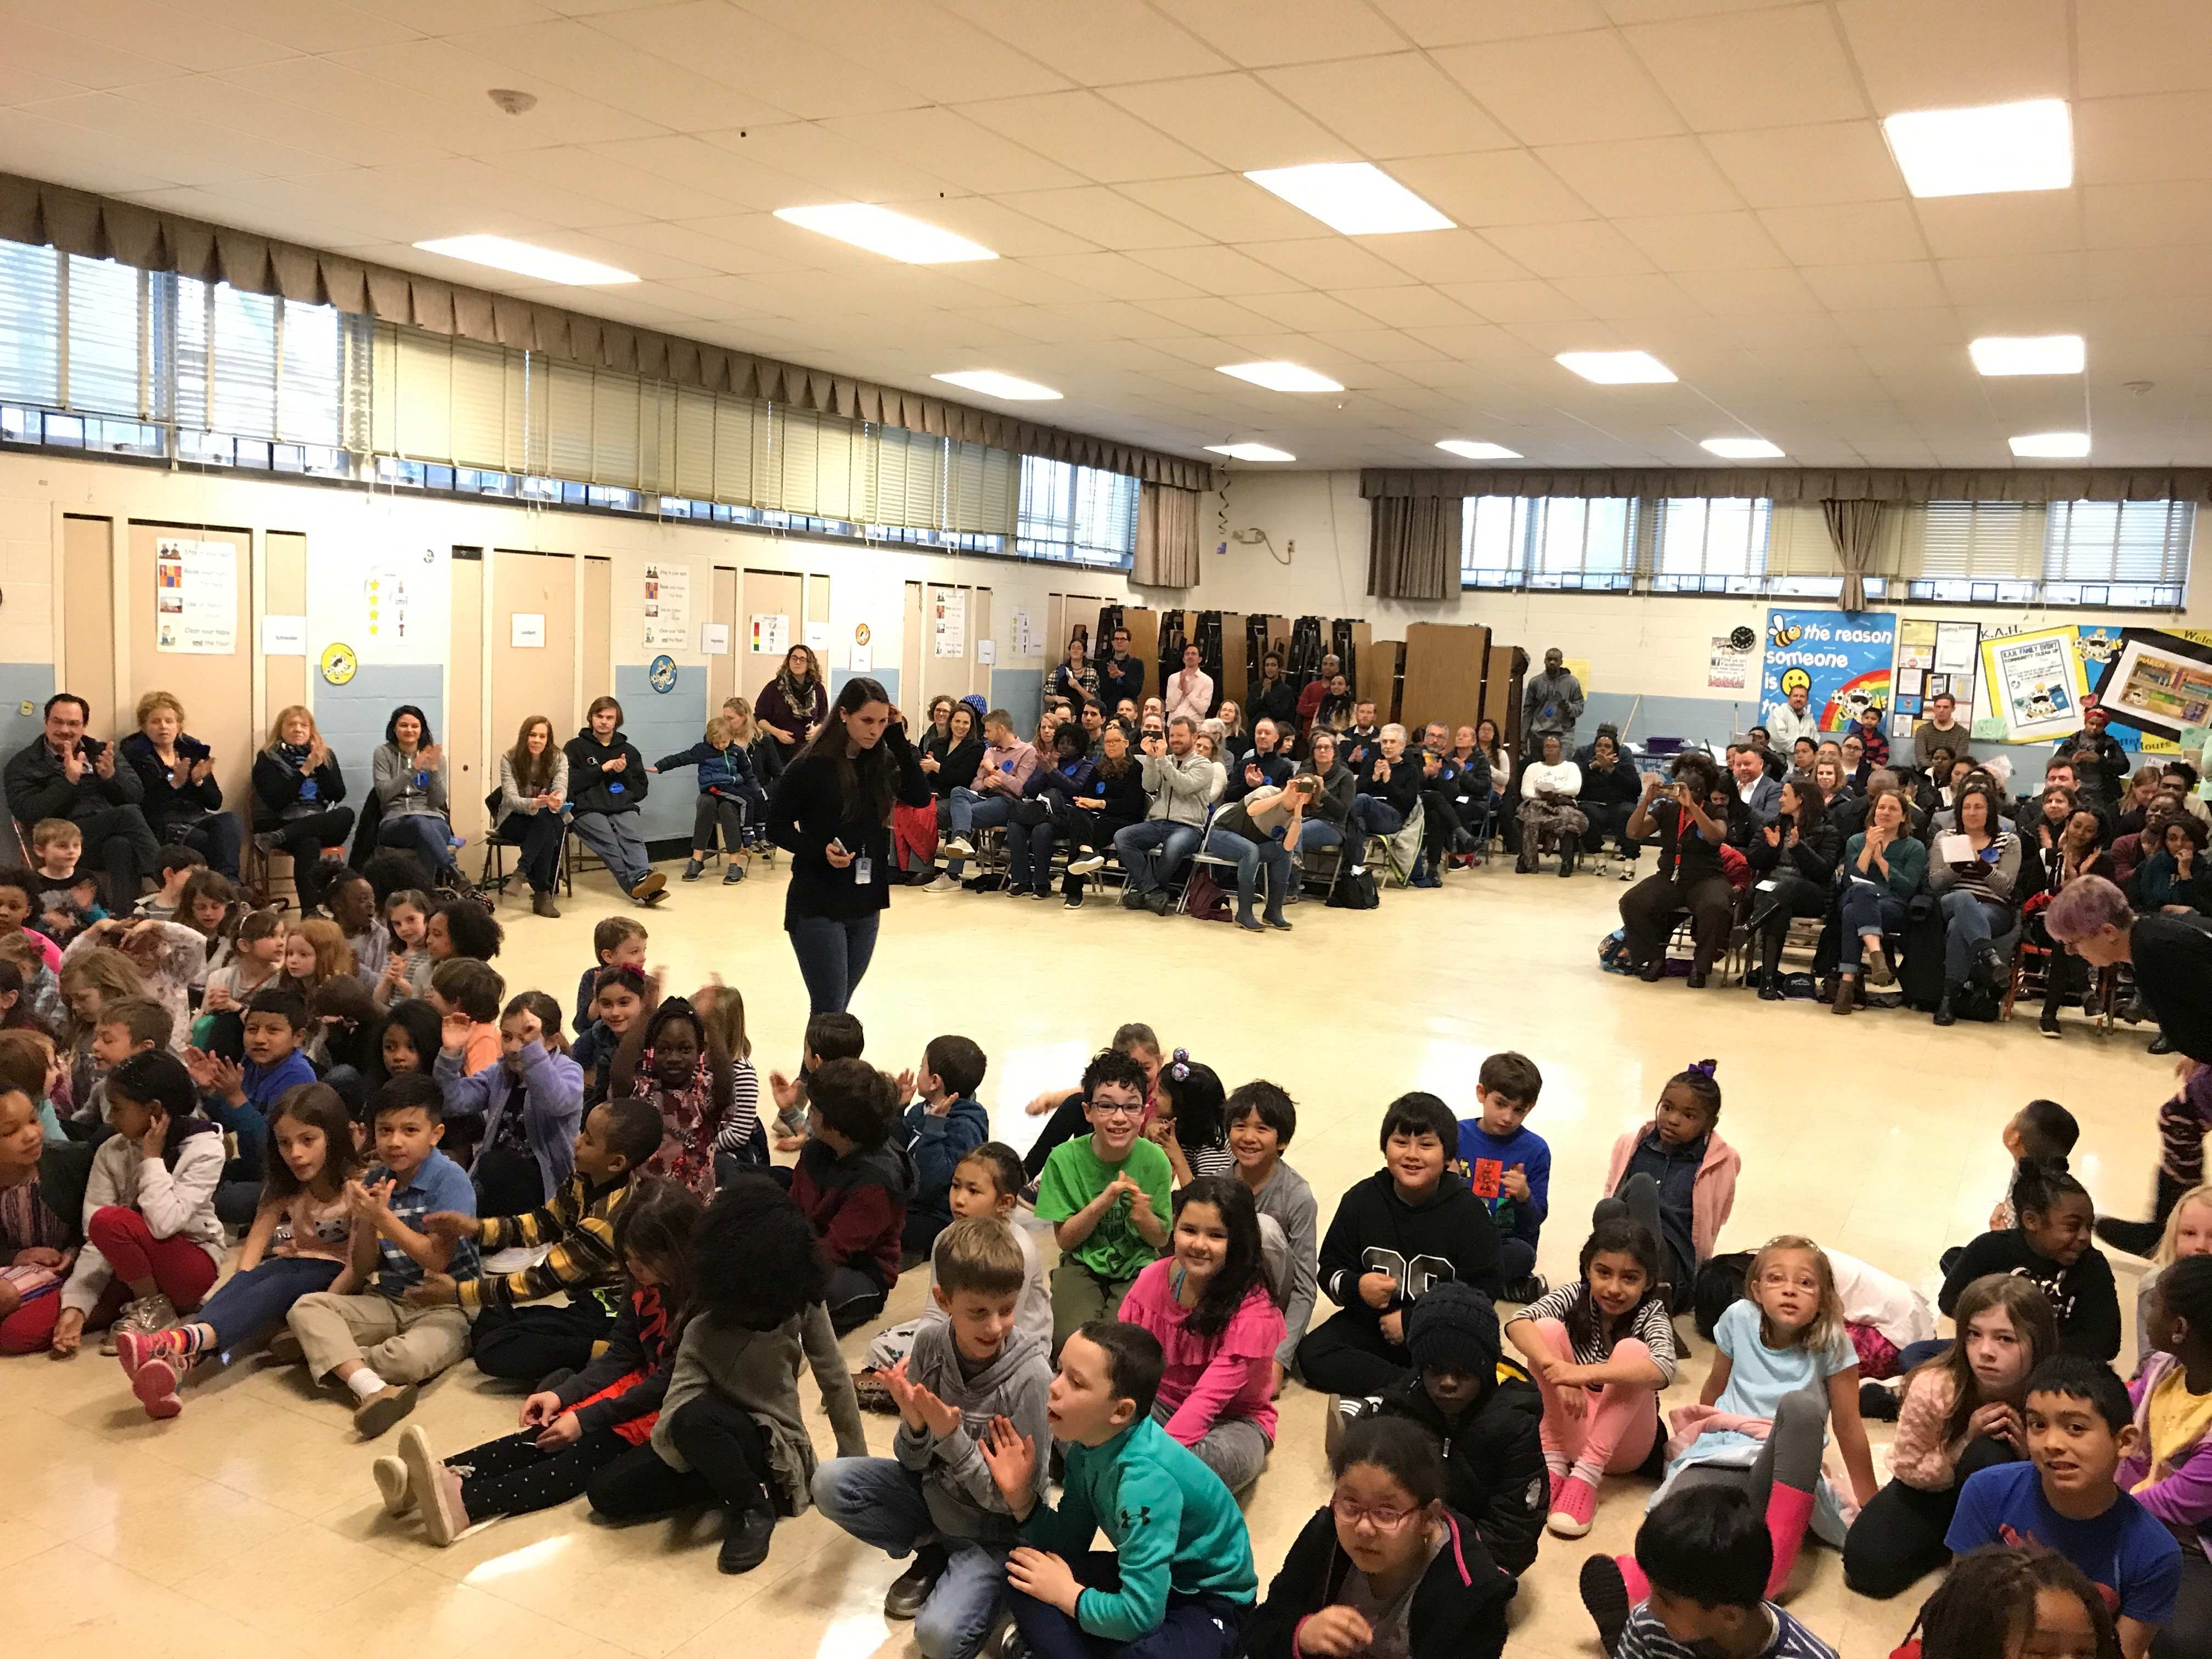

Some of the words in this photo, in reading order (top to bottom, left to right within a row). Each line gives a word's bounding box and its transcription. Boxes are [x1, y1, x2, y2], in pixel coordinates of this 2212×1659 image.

[1804, 623, 1830, 641] the
[1835, 629, 1892, 644] reason
[1980, 625, 2023, 639] K.A.H.
[1766, 651, 1848, 668] someone
[1764, 672, 1778, 689] is
